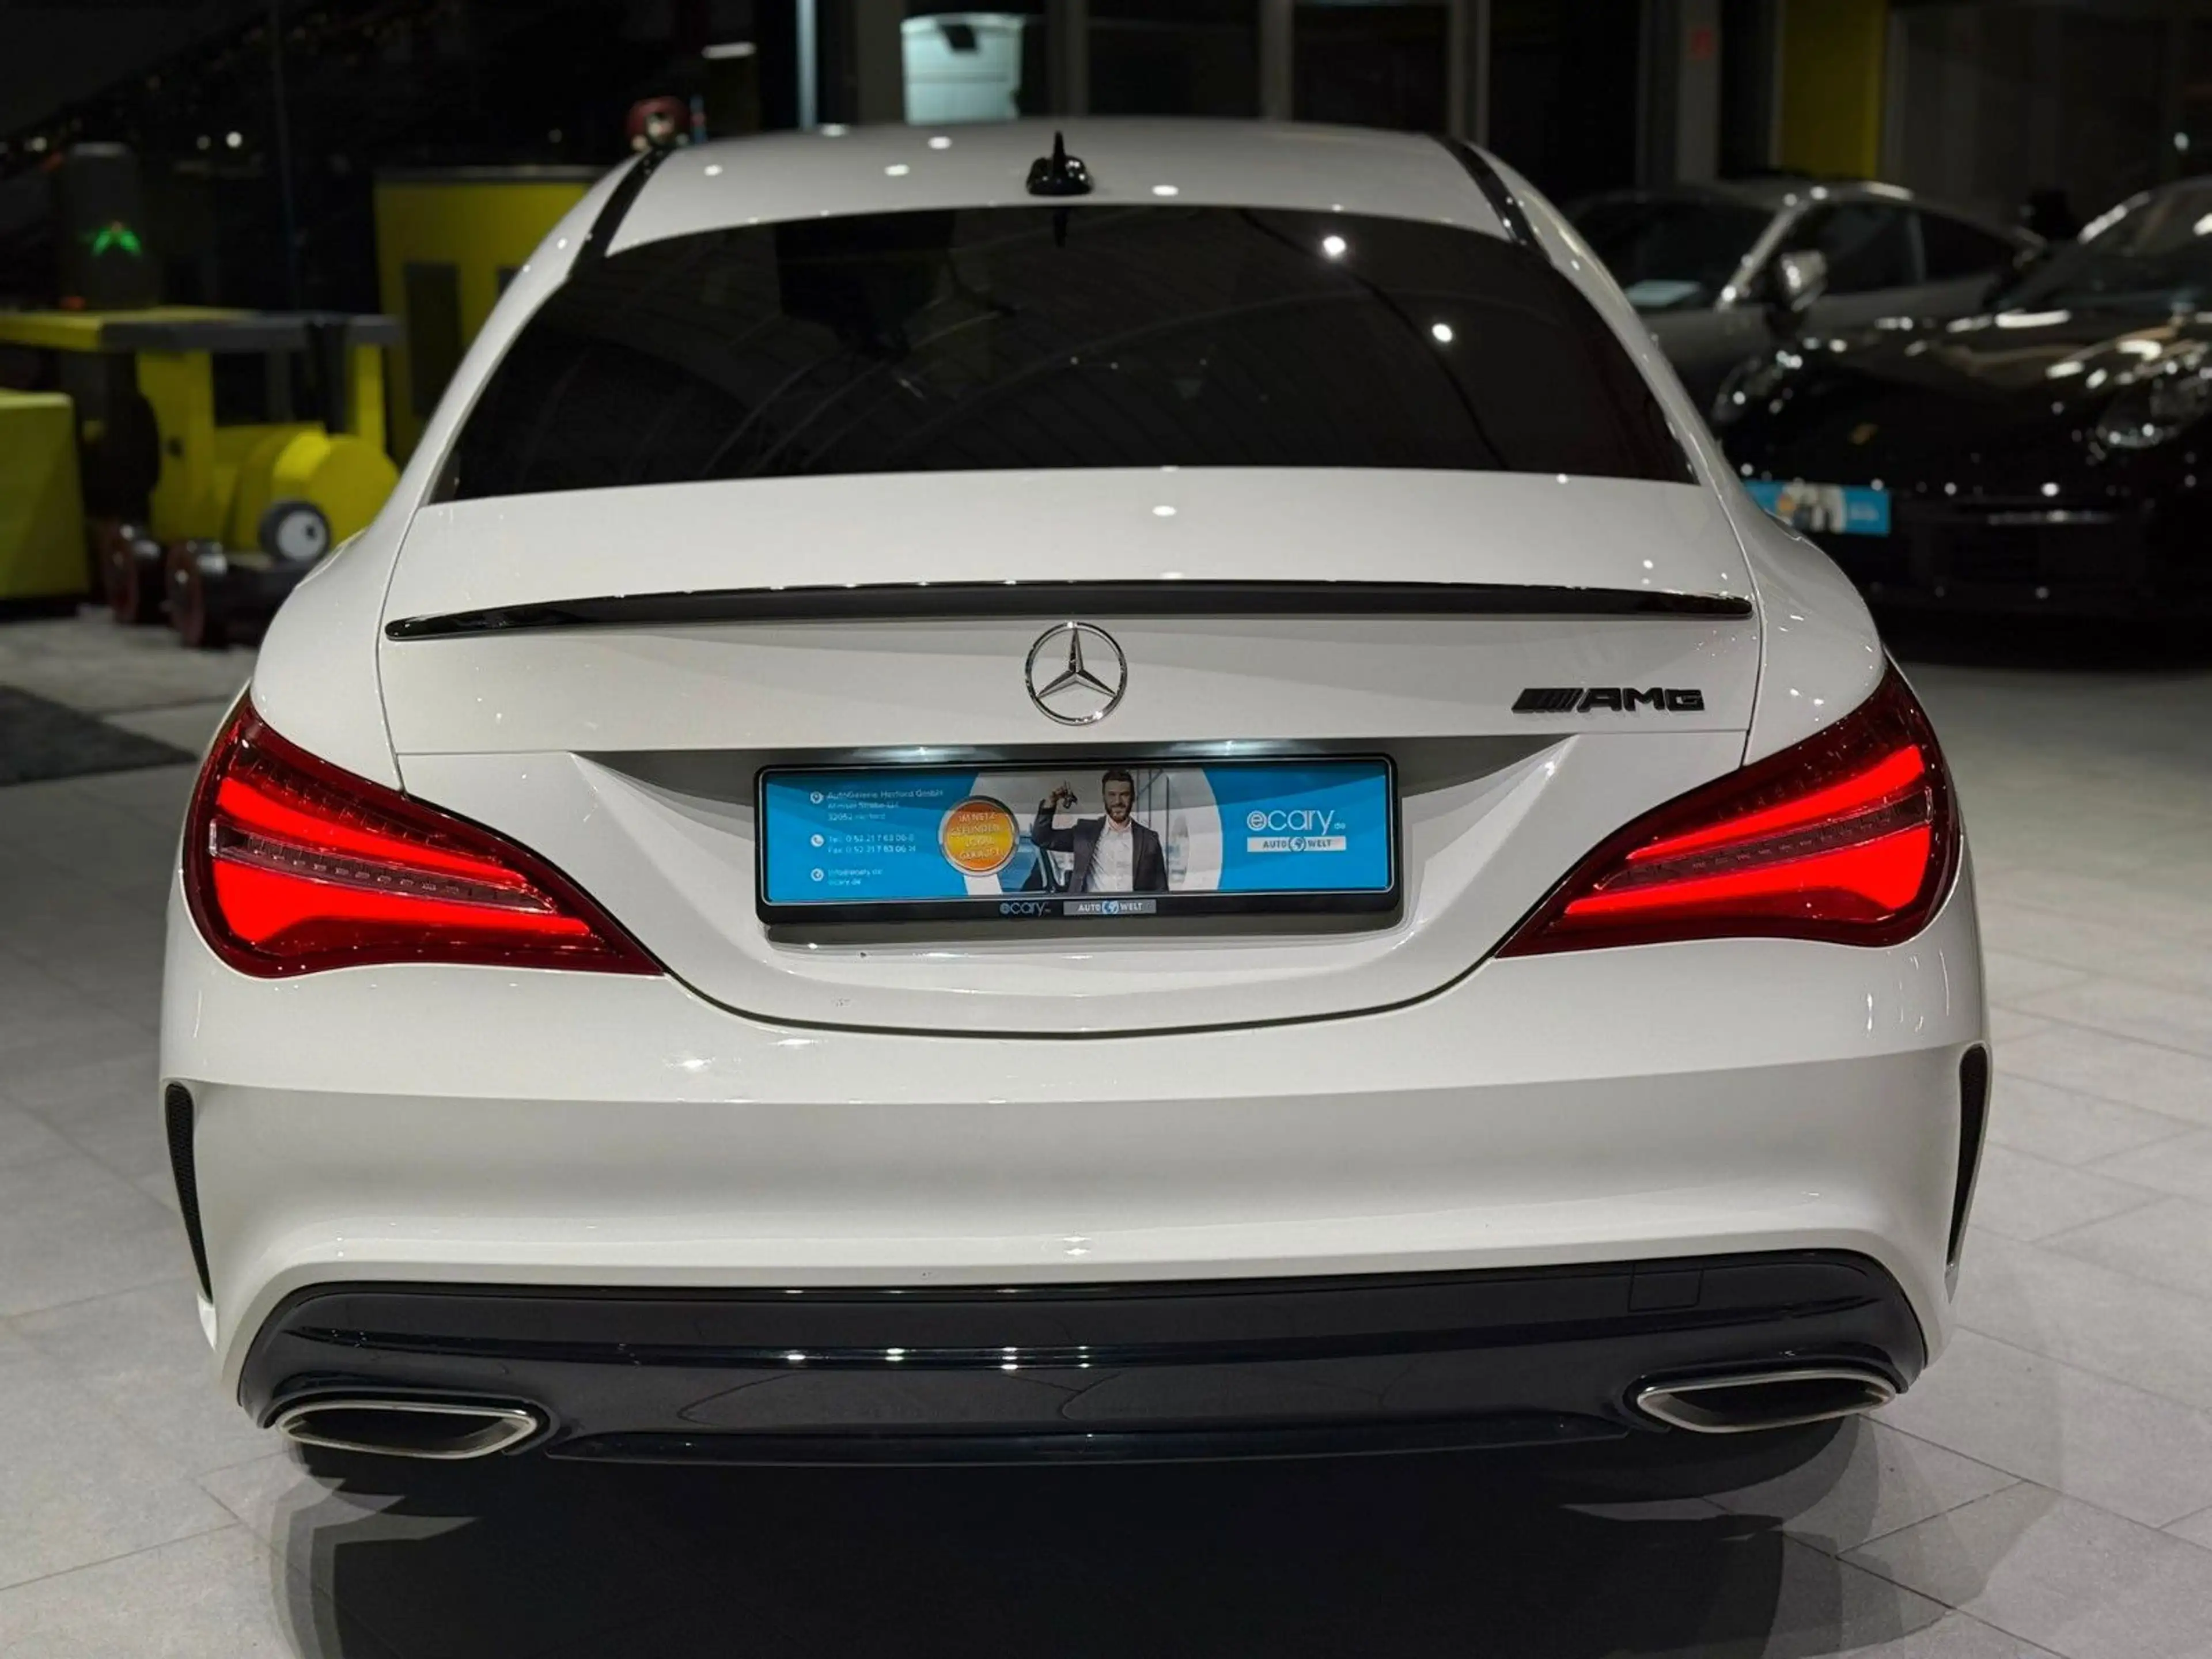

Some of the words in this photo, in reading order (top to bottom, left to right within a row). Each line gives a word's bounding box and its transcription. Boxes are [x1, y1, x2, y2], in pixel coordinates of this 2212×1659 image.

[1577, 687, 1705, 713] AMG
[1263, 840, 1287, 849] AUTO
[1308, 839, 1332, 847] WELT
[1077, 903, 1101, 912] AUTO
[1119, 902, 1143, 911] WELT
